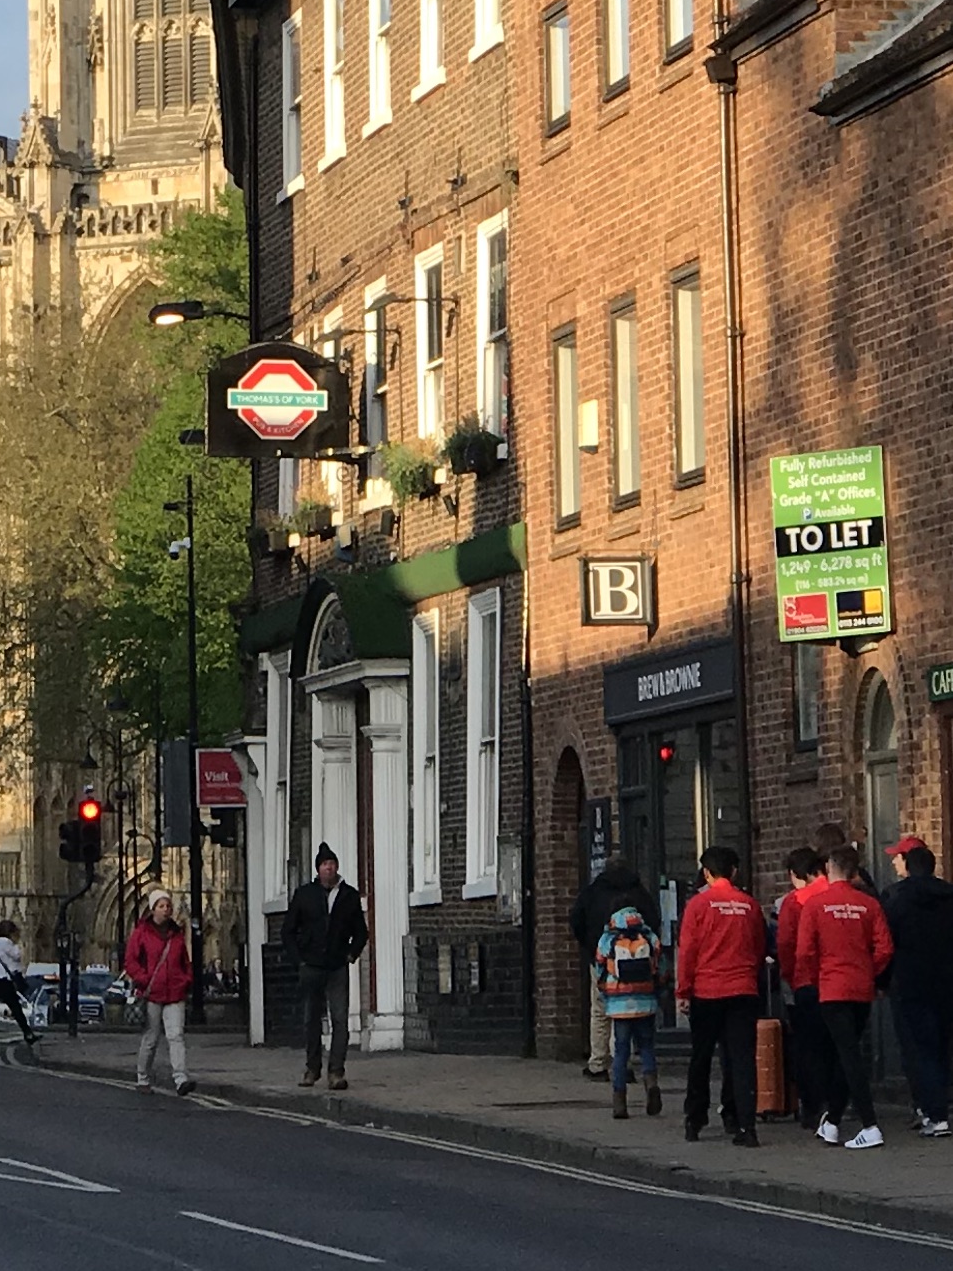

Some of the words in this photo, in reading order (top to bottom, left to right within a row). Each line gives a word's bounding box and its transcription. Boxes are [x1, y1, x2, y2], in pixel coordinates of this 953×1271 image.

[236, 394, 280, 405] THOMAS'S
[281, 395, 293, 405] OF
[294, 395, 318, 405] YORK
[779, 457, 806, 474] Fully
[808, 449, 873, 470] Refurbished
[787, 474, 809, 489] Self
[810, 468, 866, 486] Contained
[779, 491, 812, 507] Grade
[837, 485, 876, 501] Offices
[813, 505, 856, 518] Available
[784, 524, 824, 554] TO
[829, 519, 873, 549] LET
[871, 552, 883, 567] ft
[593, 566, 639, 616] B
[932, 668, 953, 696] CAF
[204, 771, 229, 782] Visit
